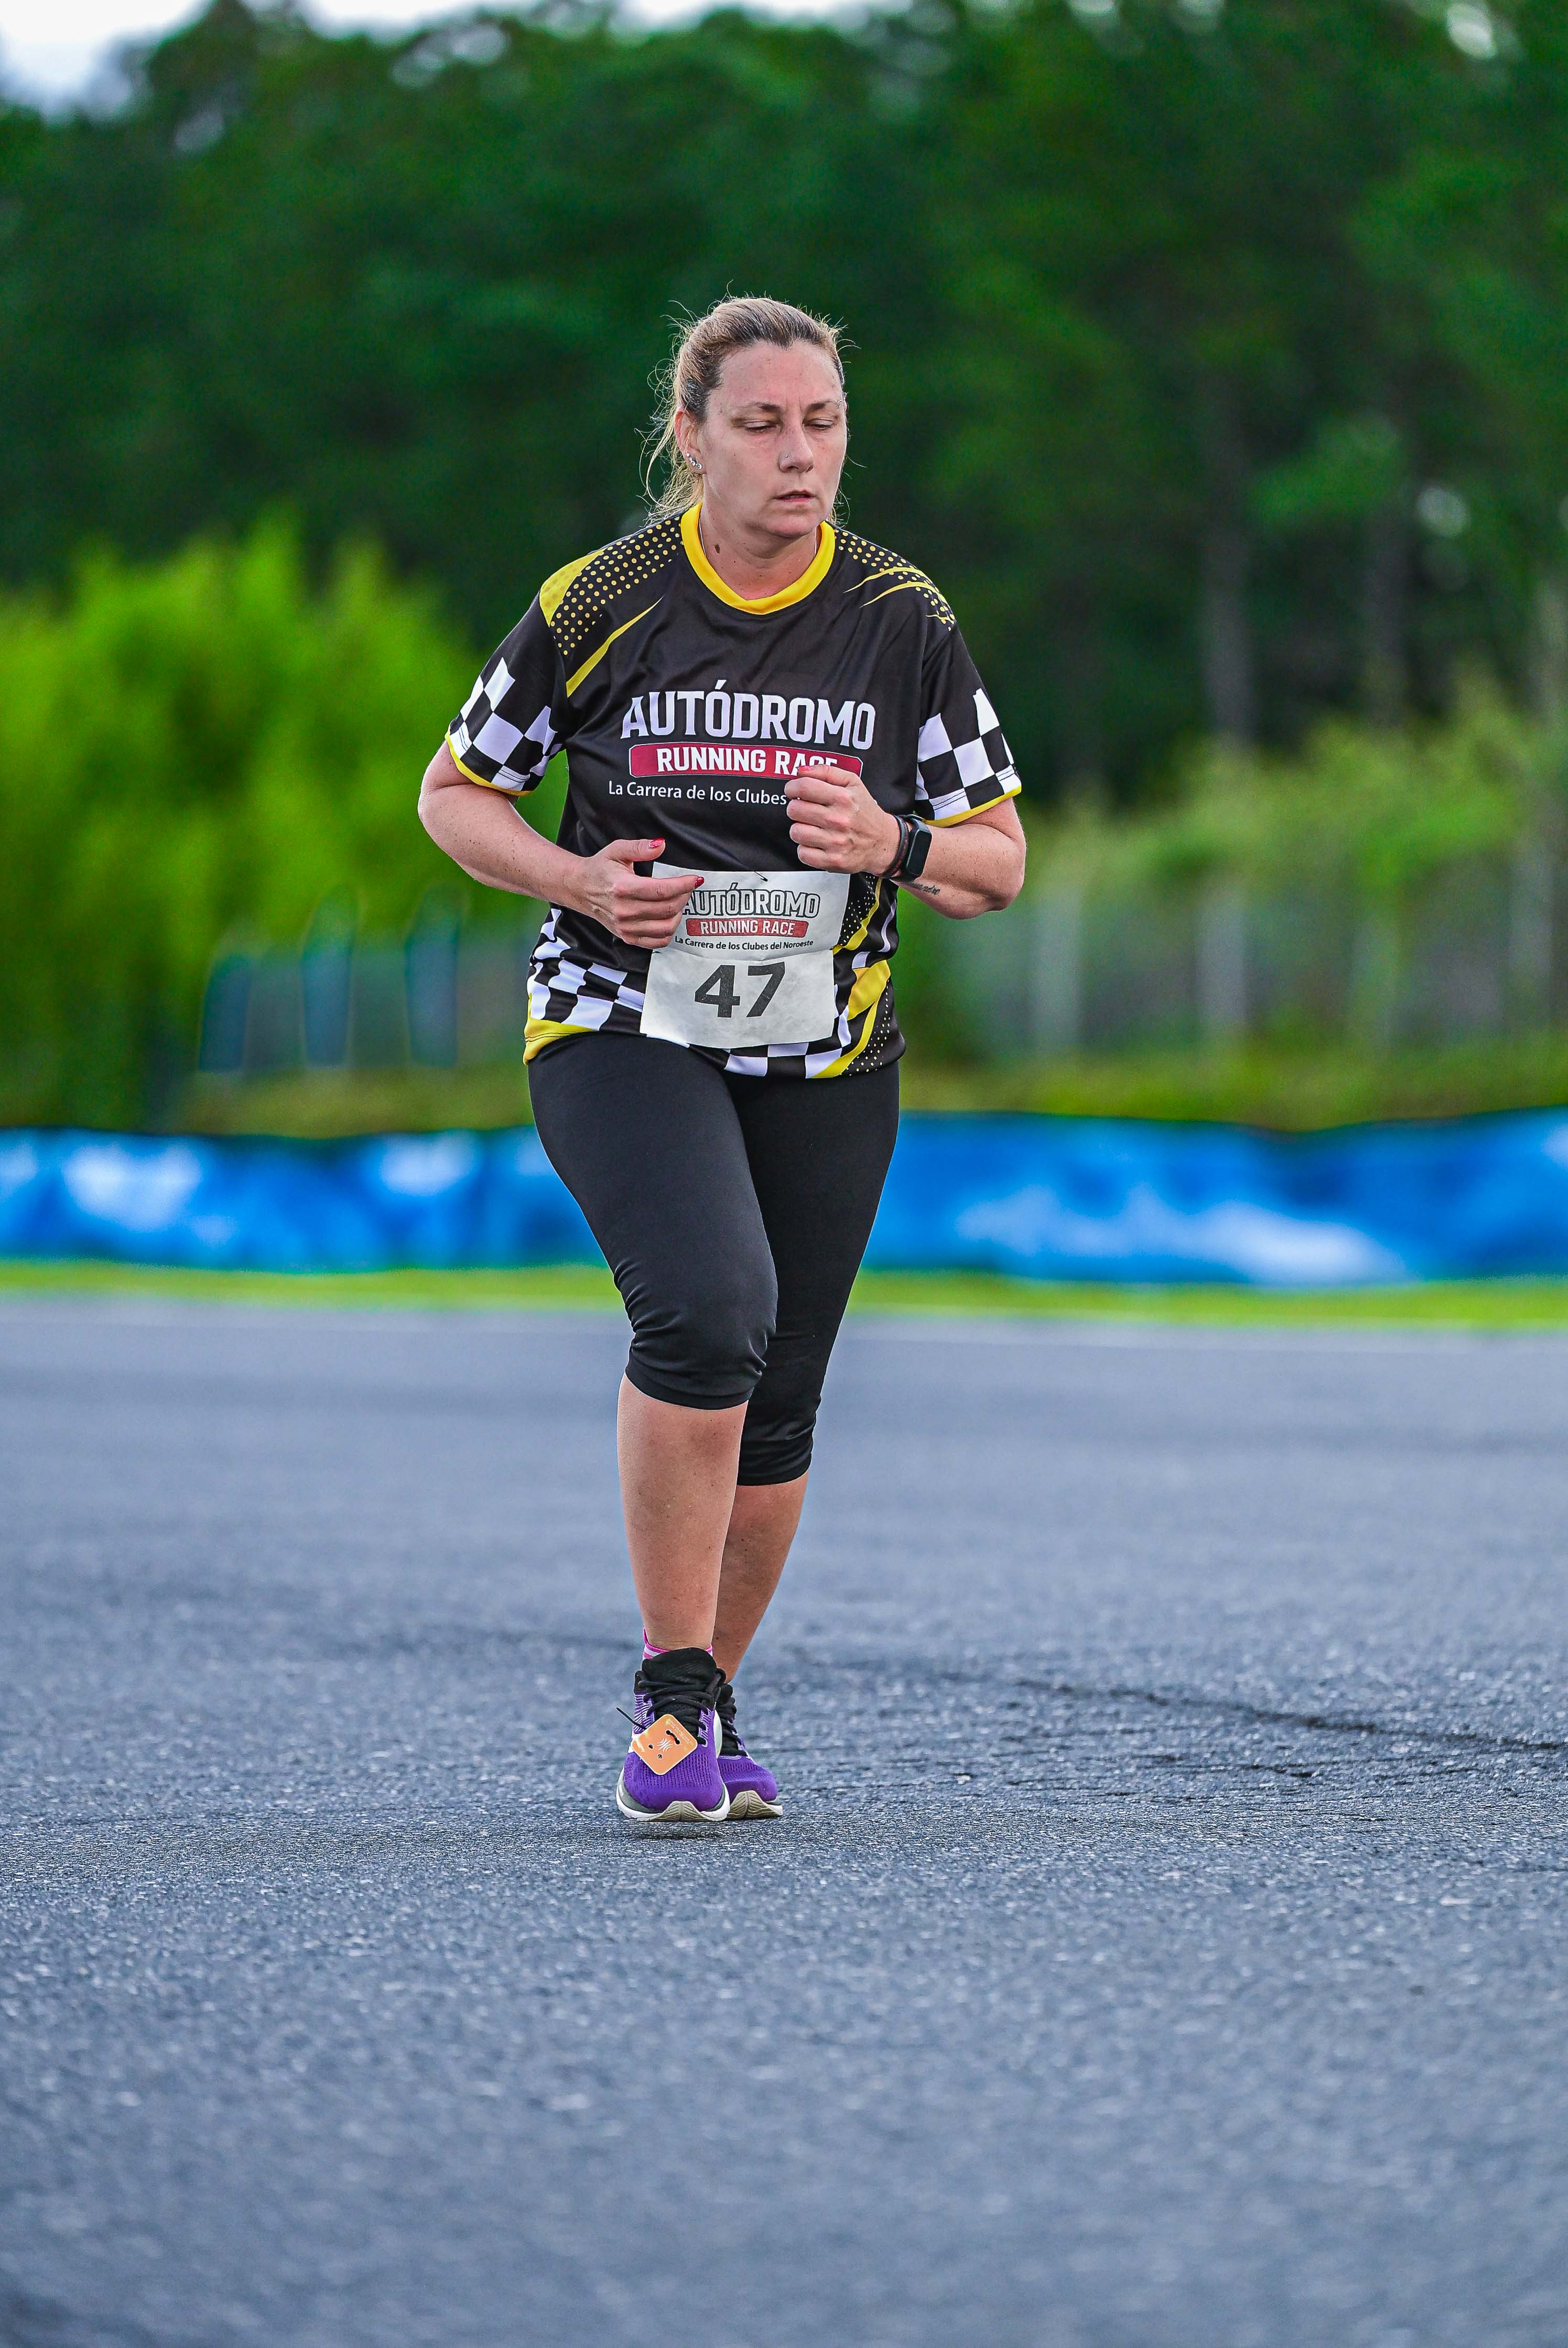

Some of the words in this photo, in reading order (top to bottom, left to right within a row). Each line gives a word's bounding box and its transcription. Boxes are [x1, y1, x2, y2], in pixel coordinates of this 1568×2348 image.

[620, 680, 876, 750] AUTÓDROMO
[656, 748, 766, 773] RUNNING
[608, 780, 623, 795] La
[626, 781, 682, 799] Carrera
[686, 785, 706, 800] de
[709, 786, 731, 802] los
[736, 788, 787, 805] Clubes
[682, 882, 821, 919] AUTÓDROMO
[700, 920, 759, 934] RUNNING
[762, 920, 796, 935] RACE
[675, 935, 684, 944] La
[685, 938, 714, 950] Carrera
[715, 941, 727, 950] de
[728, 942, 740, 950] los
[742, 942, 769, 951] Clubes
[770, 941, 782, 950] del
[783, 940, 814, 949] Noroeste
[694, 961, 785, 1019] 47
